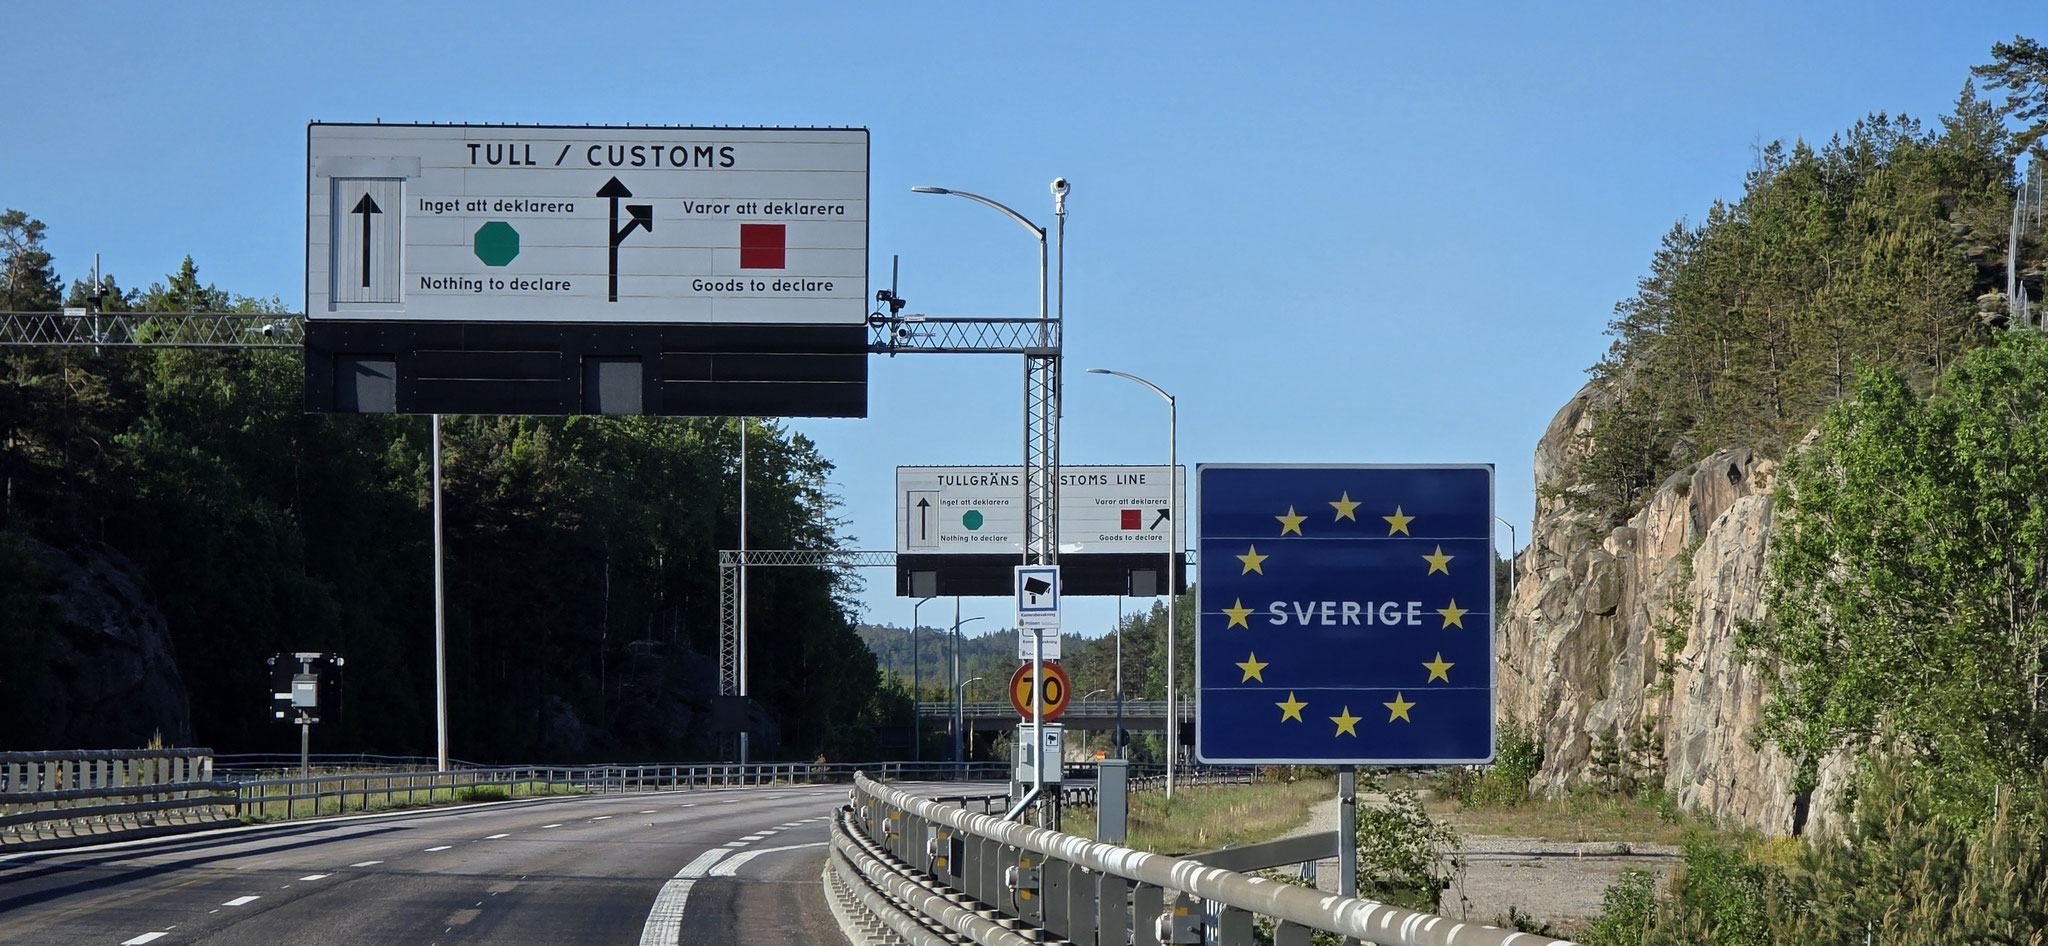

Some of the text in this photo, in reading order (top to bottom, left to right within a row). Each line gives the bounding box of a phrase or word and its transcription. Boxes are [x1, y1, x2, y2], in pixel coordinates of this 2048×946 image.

[467, 143, 735, 168] TULL / CUSTOMS
[419, 198, 575, 215] Inget att deklarera
[683, 199, 845, 215] Varor att deklarera
[420, 276, 571, 293] Nothing to declare
[692, 277, 834, 292] Goods to declare
[937, 472, 1019, 486] TULLGRÄNS
[1116, 474, 1146, 485] LINE
[940, 499, 958, 507] Inget
[940, 535, 969, 543] Nothing
[1269, 601, 1423, 626] SVERIGE
[1023, 677, 1062, 706] 70
